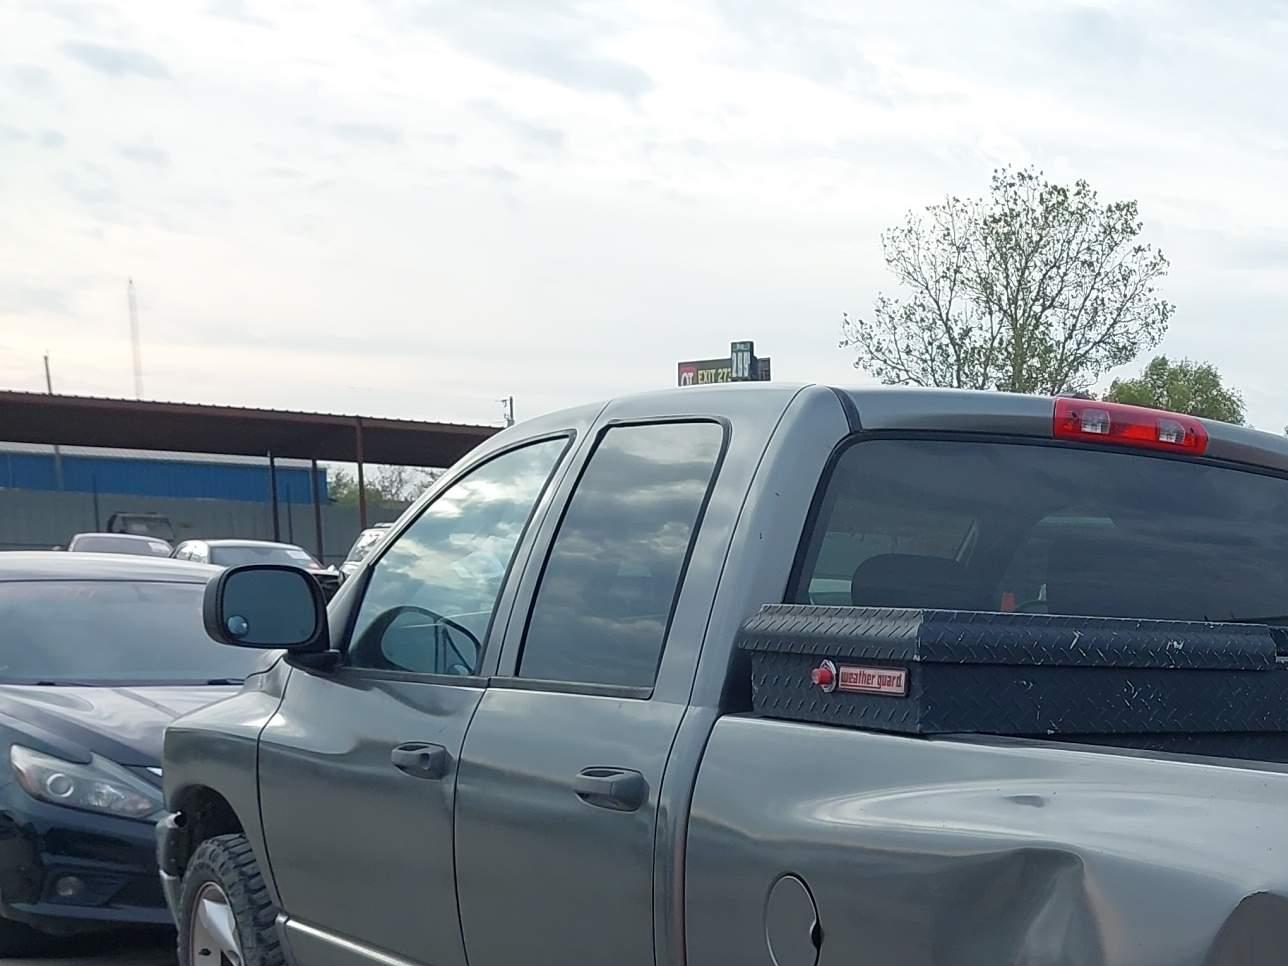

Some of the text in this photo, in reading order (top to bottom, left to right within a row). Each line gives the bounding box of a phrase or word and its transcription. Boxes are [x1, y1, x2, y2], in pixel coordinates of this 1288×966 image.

[698, 369, 716, 384] EXIT
[841, 671, 902, 688] weather guard
